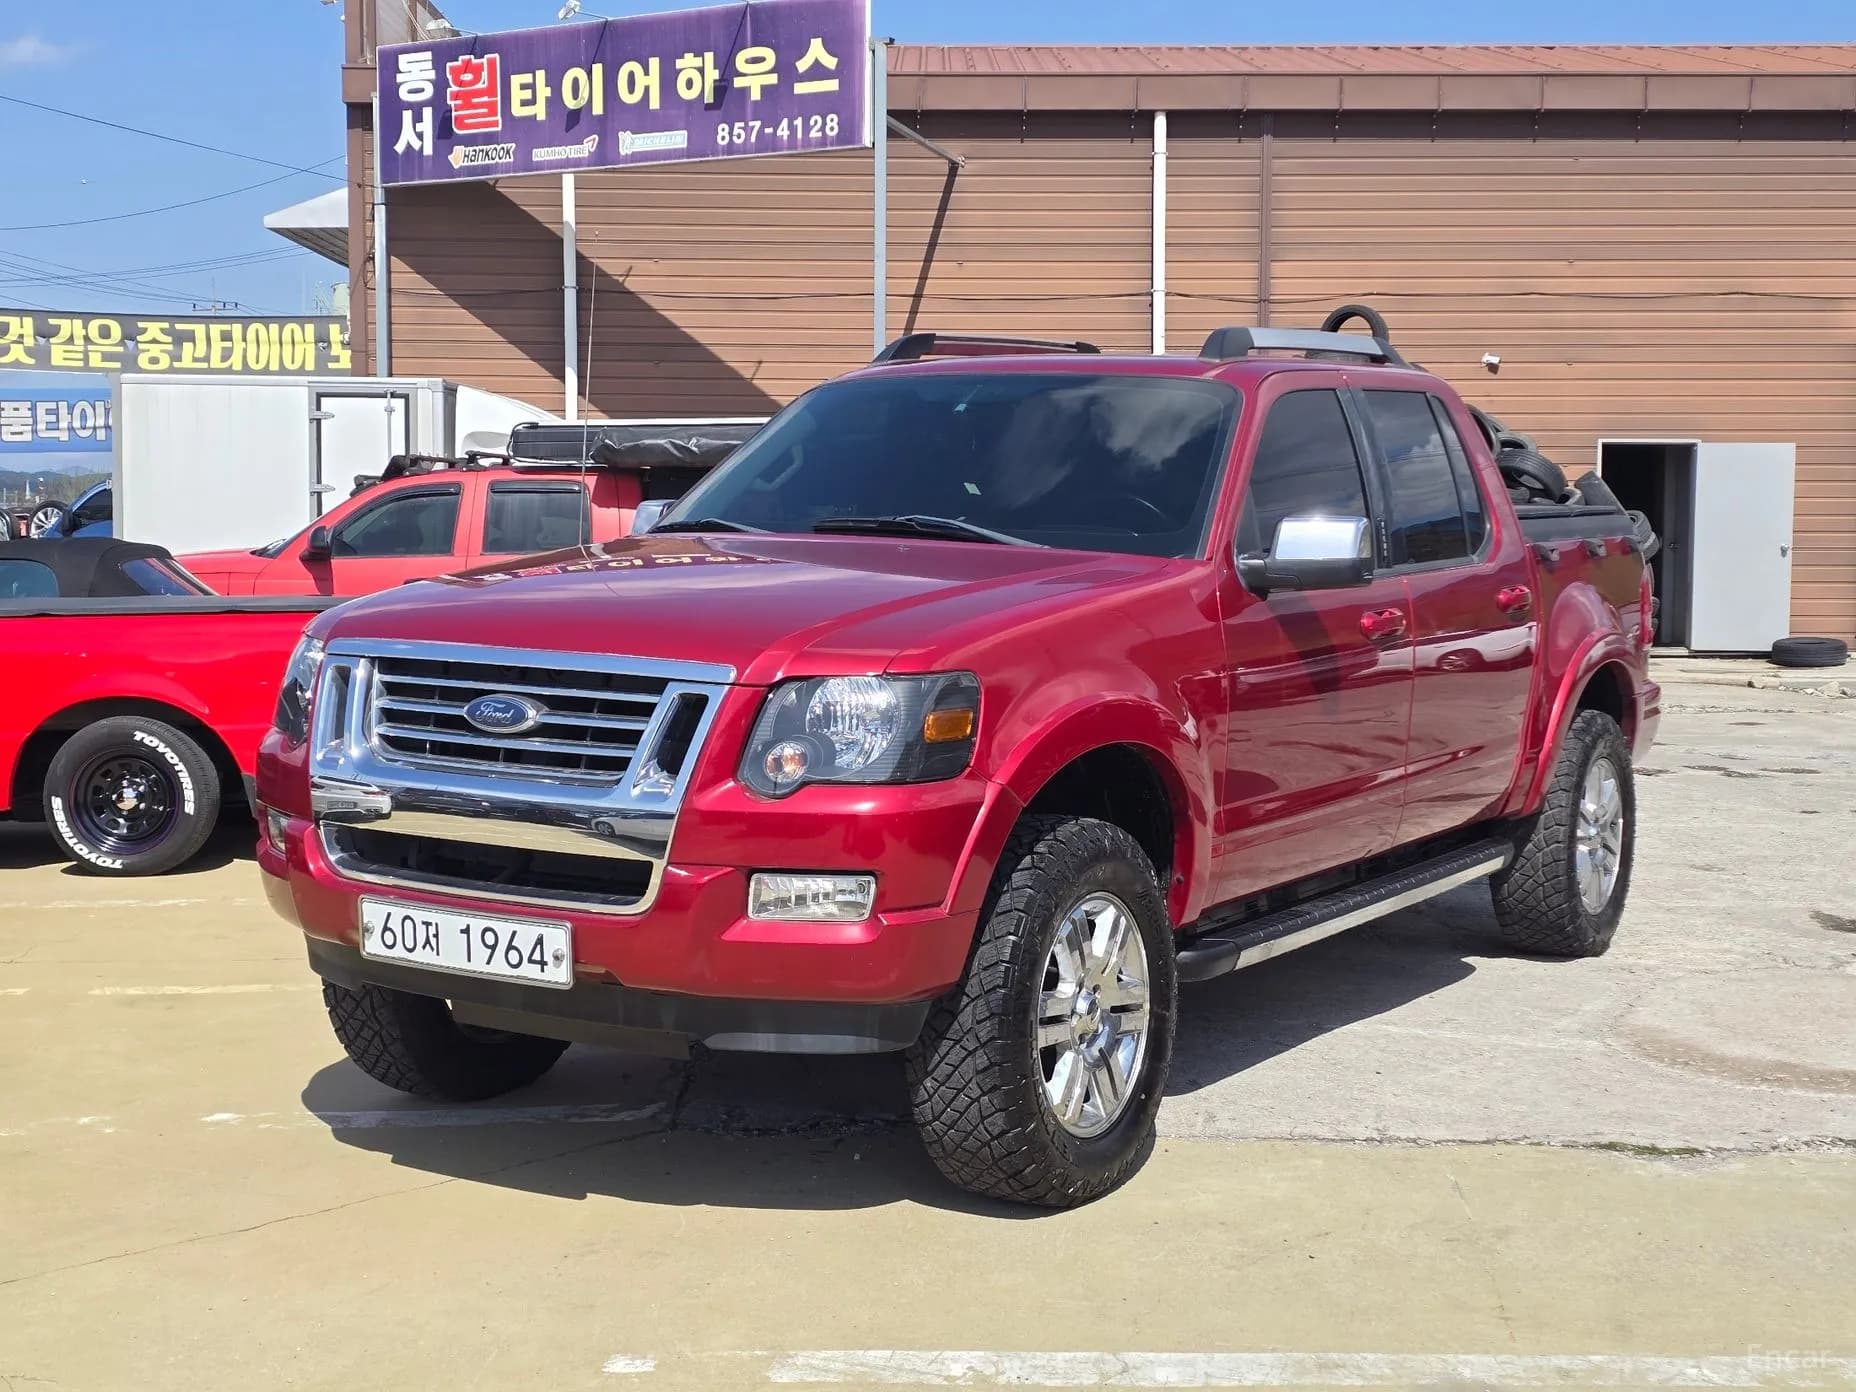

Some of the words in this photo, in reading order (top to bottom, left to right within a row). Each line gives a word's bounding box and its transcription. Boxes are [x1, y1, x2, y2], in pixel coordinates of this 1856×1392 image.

[717, 113, 839, 145] 857-4128
[534, 147, 567, 160] KUMHO
[568, 146, 587, 158] TIRE
[48, 318, 124, 368] 같은
[136, 322, 316, 371] 중고타이어
[0, 400, 112, 442] 품타이
[475, 701, 515, 720] Ford
[380, 912, 440, 957] 60저
[459, 923, 549, 973] 1964
